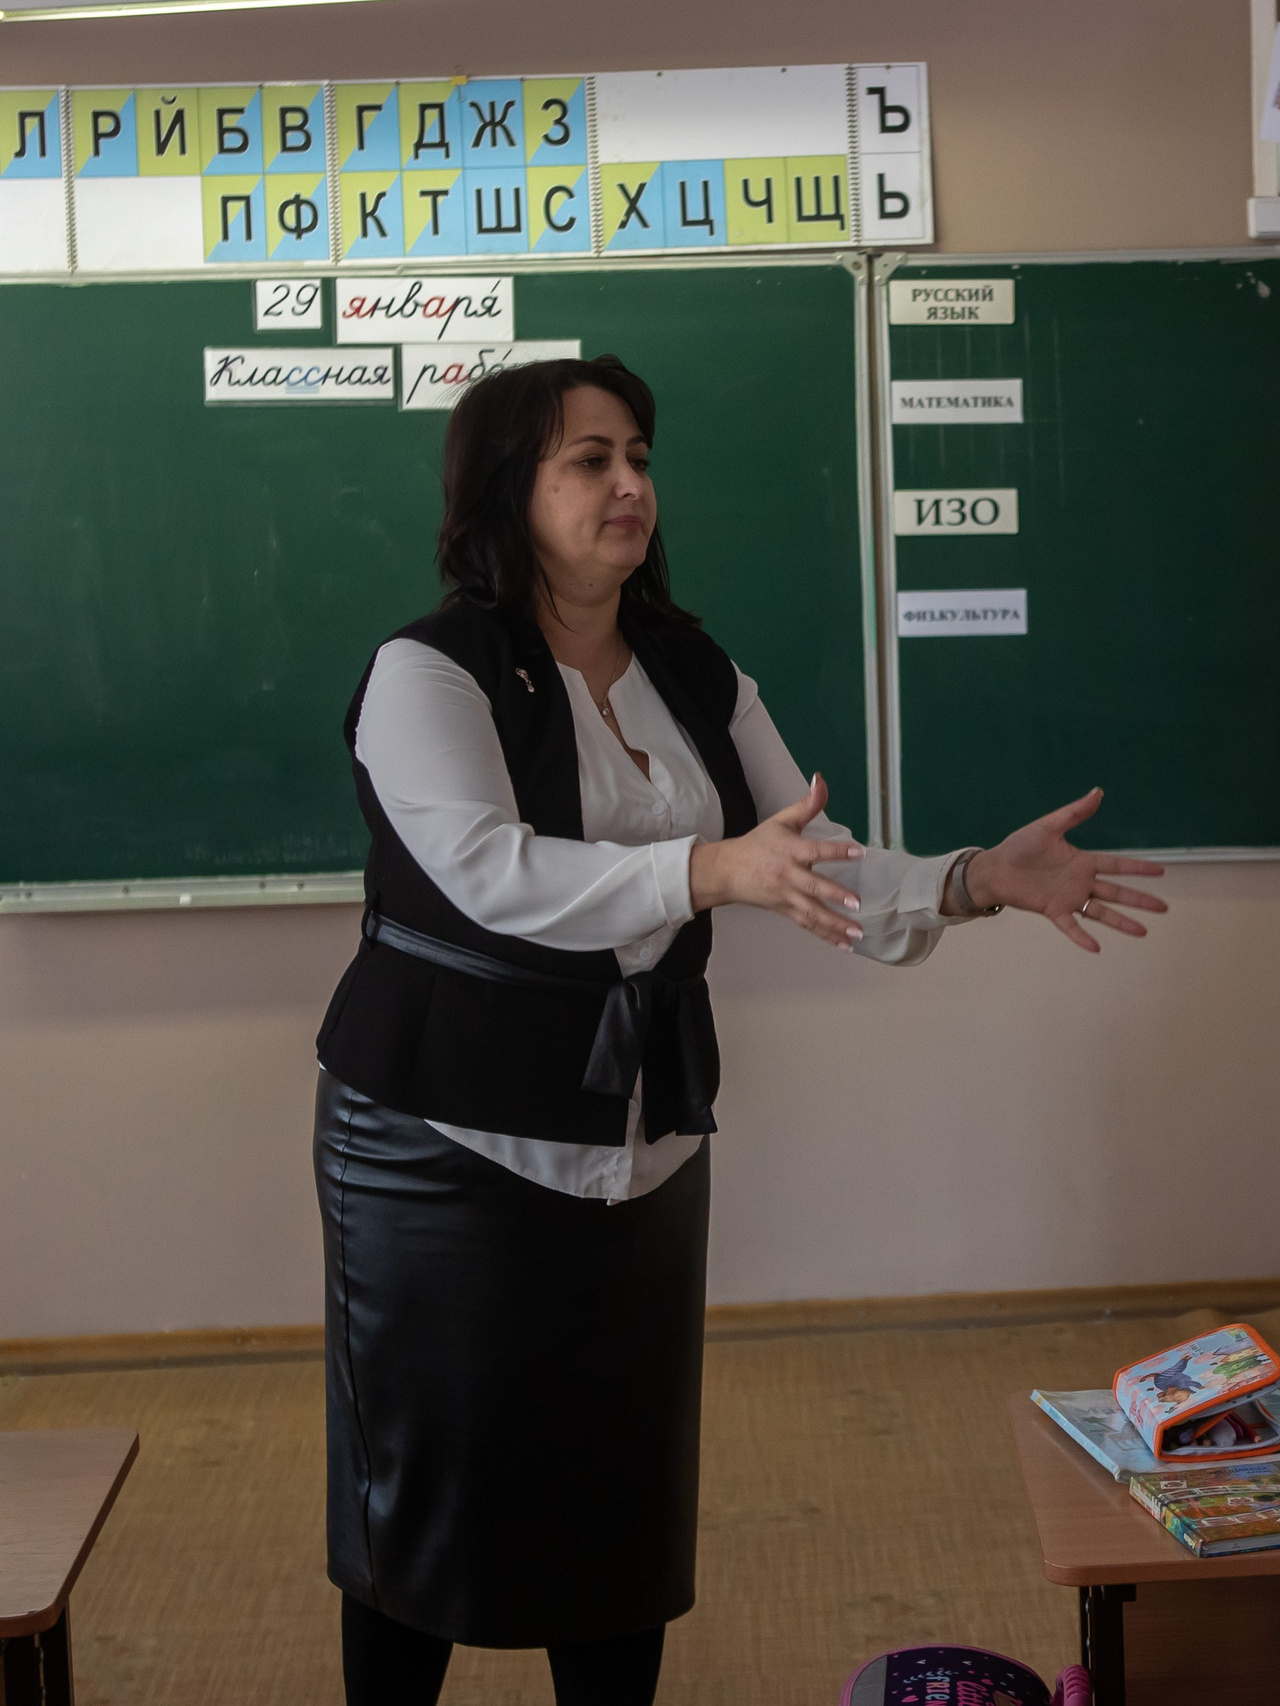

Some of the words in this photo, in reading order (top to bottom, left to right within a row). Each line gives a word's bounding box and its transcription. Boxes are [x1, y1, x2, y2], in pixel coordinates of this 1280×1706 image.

[14, 110, 46, 158] Л
[92, 110, 121, 157] Р
[154, 95, 186, 156] Й
[216, 107, 249, 154] Б
[279, 106, 312, 153] В
[356, 104, 383, 151] Г
[413, 102, 450, 160] Д
[469, 100, 516, 148] Ж
[541, 98, 571, 146] З
[867, 86, 911, 134] Ъ
[221, 195, 252, 242] П
[277, 194, 319, 240] Ф
[359, 191, 388, 238] К
[420, 190, 449, 236] Т
[475, 187, 522, 235] Ш
[543, 185, 577, 233] С
[616, 182, 650, 230] Х
[679, 180, 715, 236] Ц
[742, 177, 774, 224] Ч
[795, 175, 846, 231] Щ
[877, 173, 910, 220] Ь
[263, 283, 319, 317] 29
[911, 285, 995, 303] РУССКИЙ
[926, 306, 980, 321] ЯЗЫК
[209, 354, 392, 387] Классная
[900, 396, 1015, 409] МАТЕМАТИКА
[914, 497, 1001, 527] ИЗО
